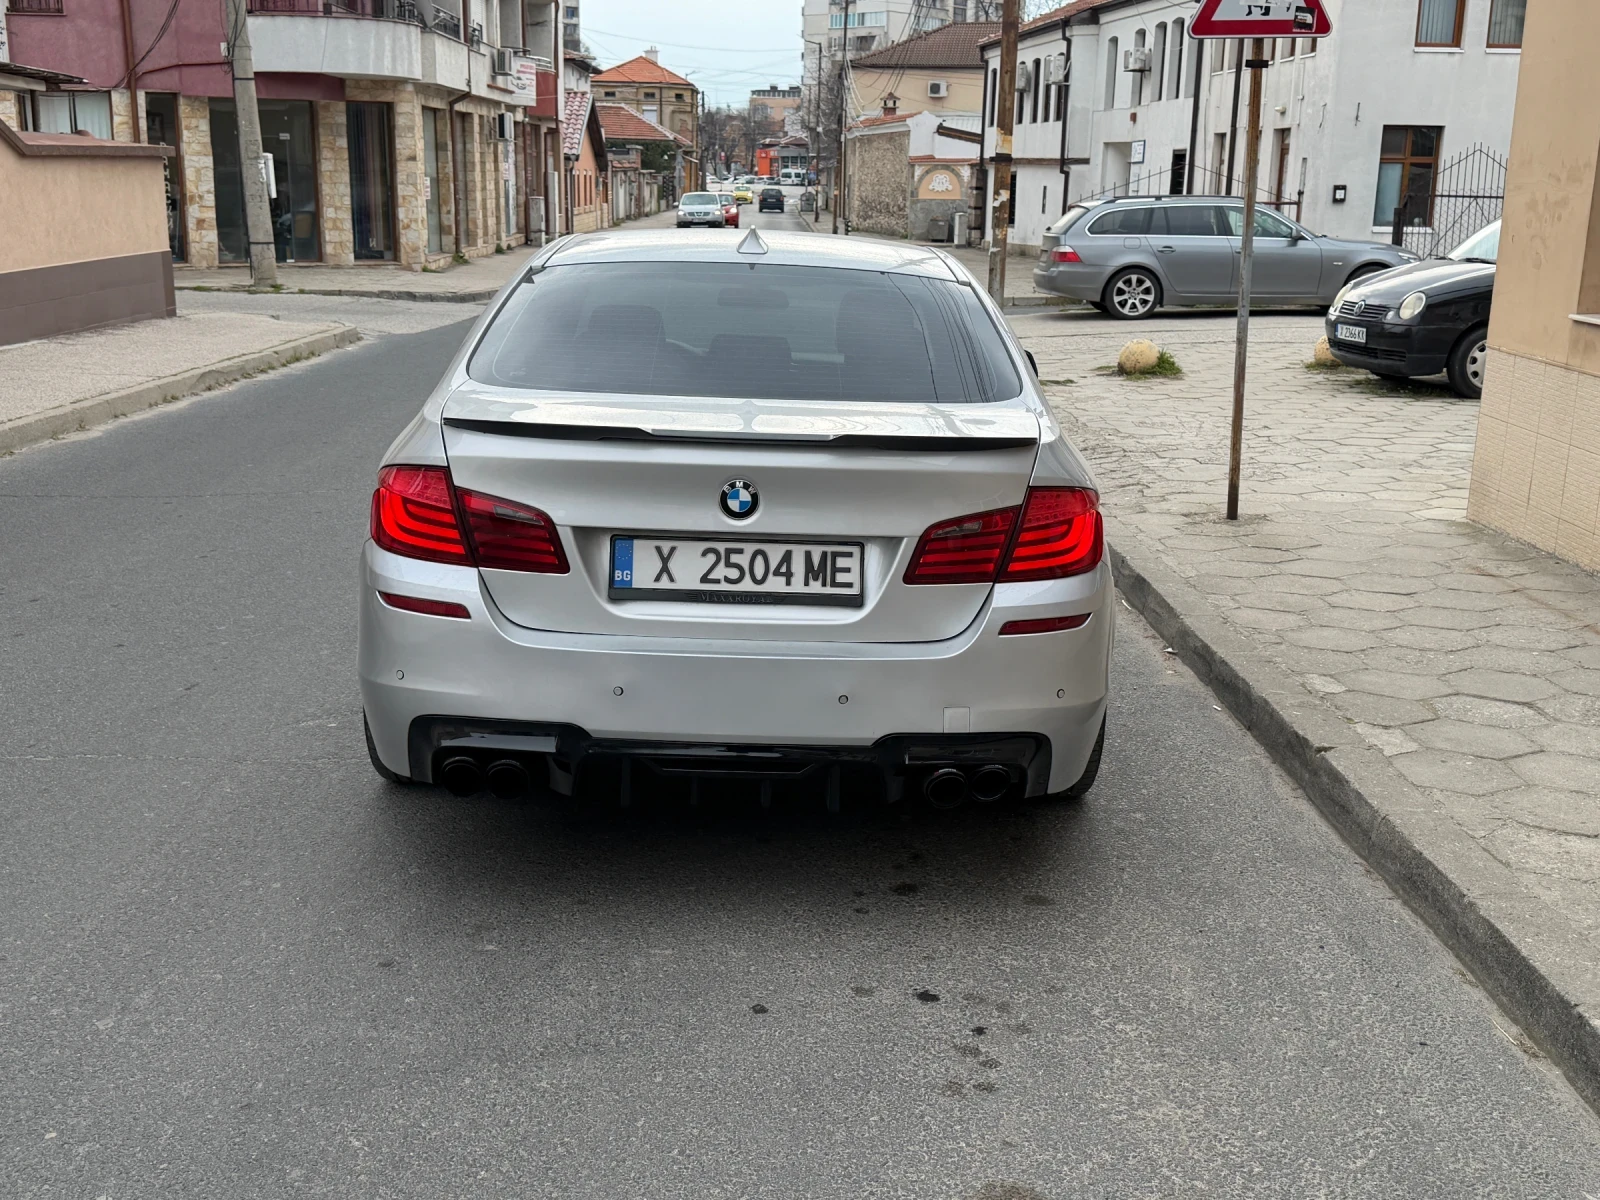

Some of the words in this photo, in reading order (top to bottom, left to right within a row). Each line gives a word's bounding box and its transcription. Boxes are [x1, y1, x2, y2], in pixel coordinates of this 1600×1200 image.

[723, 480, 757, 494] BMW
[653, 545, 678, 583] X
[699, 547, 794, 586] 2504
[803, 550, 854, 588] ME
[614, 570, 631, 581] BG
